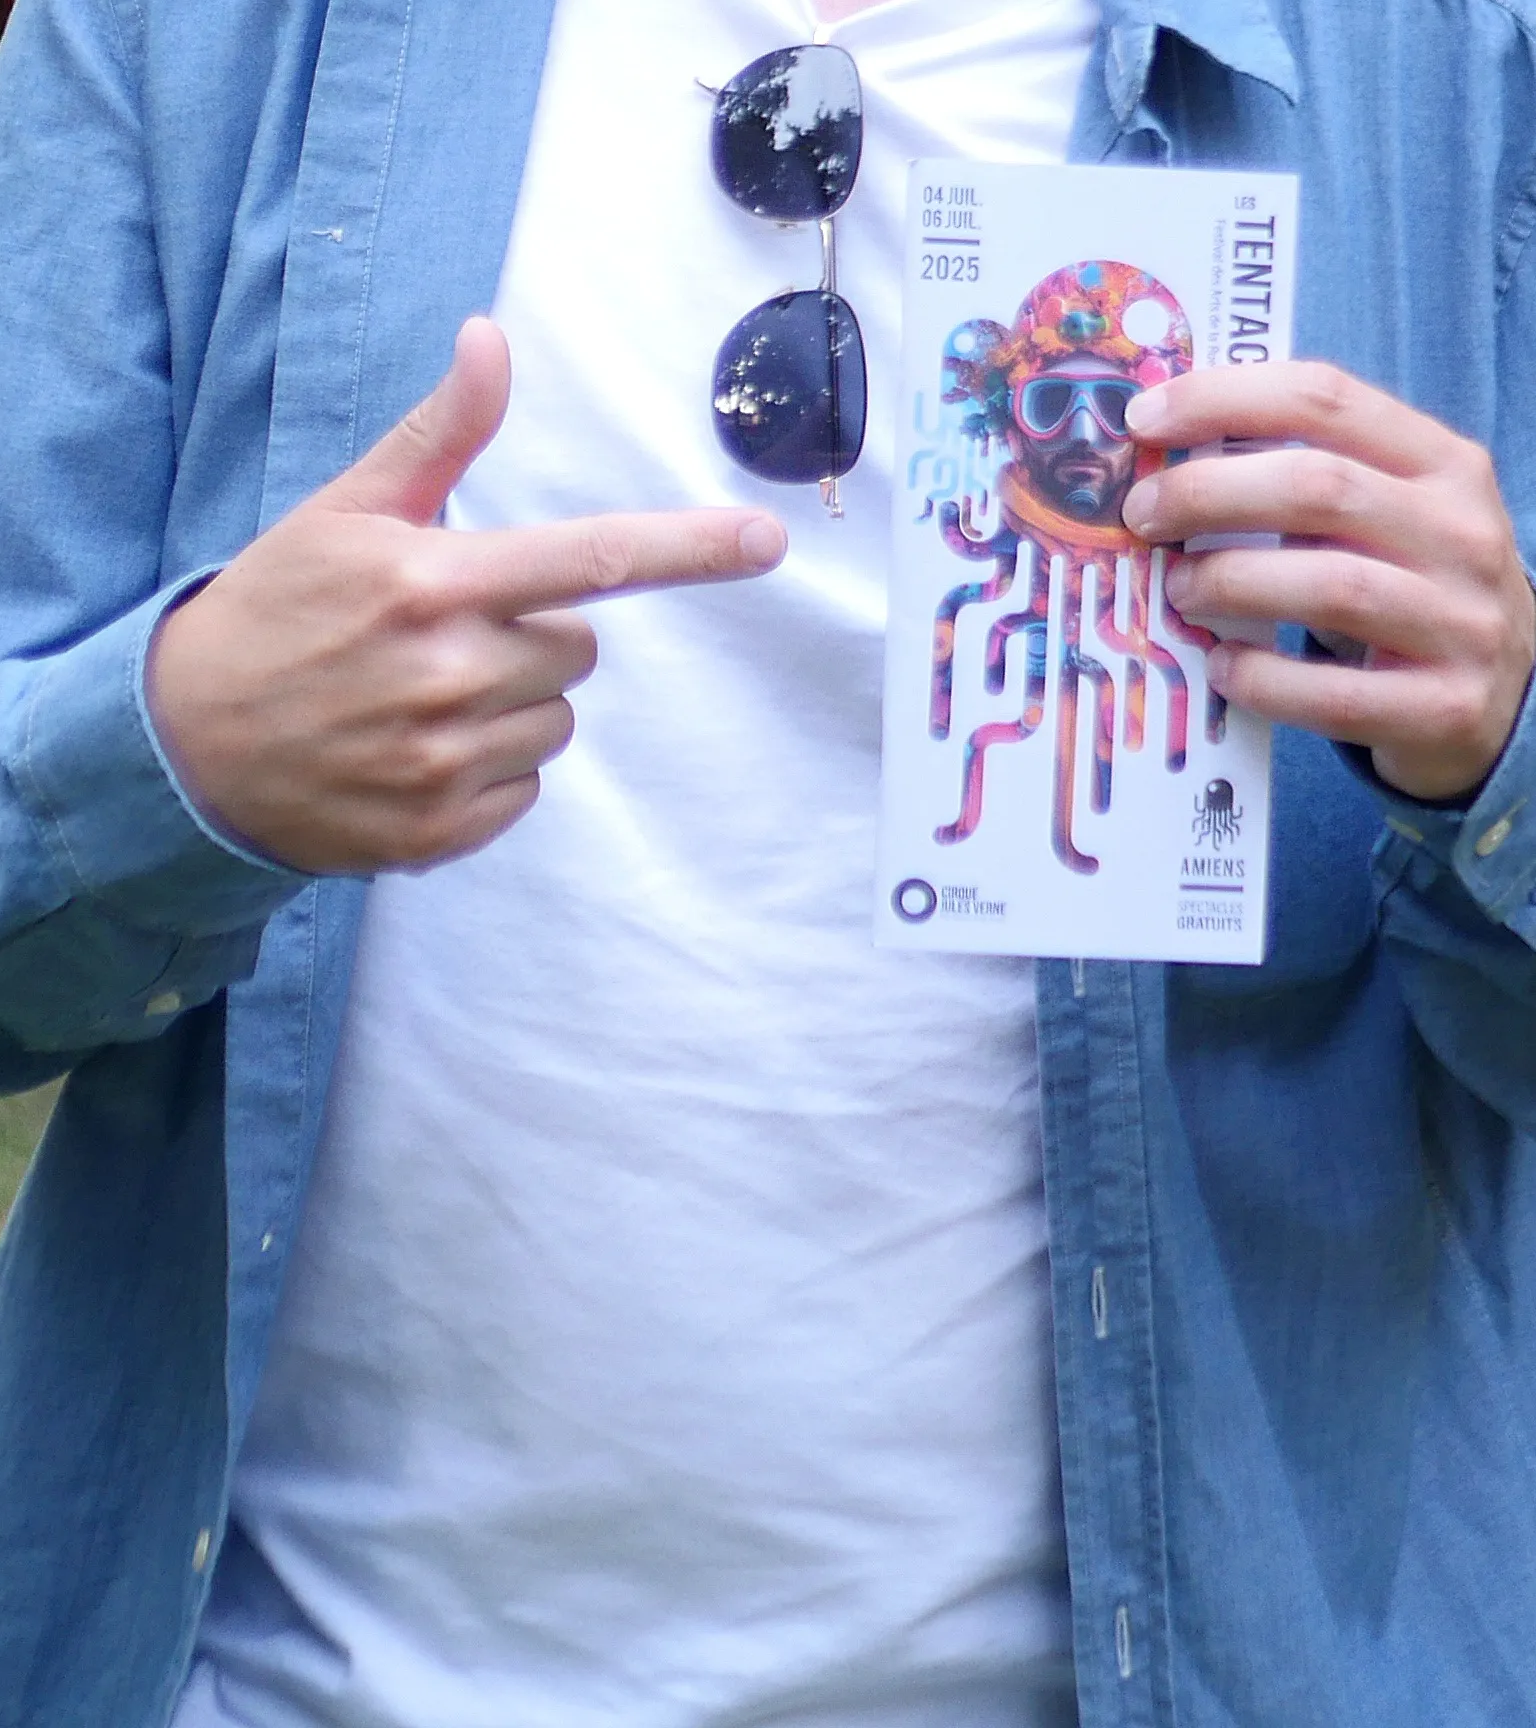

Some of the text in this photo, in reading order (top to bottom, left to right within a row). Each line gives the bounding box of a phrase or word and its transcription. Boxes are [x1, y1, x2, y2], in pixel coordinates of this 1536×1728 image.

[923, 184, 983, 207] 04 JUIL.
[1234, 196, 1257, 211] LES
[922, 208, 981, 230] 06 JUIL.
[920, 254, 980, 283] 2025
[1227, 215, 1275, 365] TENTAC
[1181, 857, 1245, 877] AMIENS
[1176, 915, 1243, 932] GRATUITS
